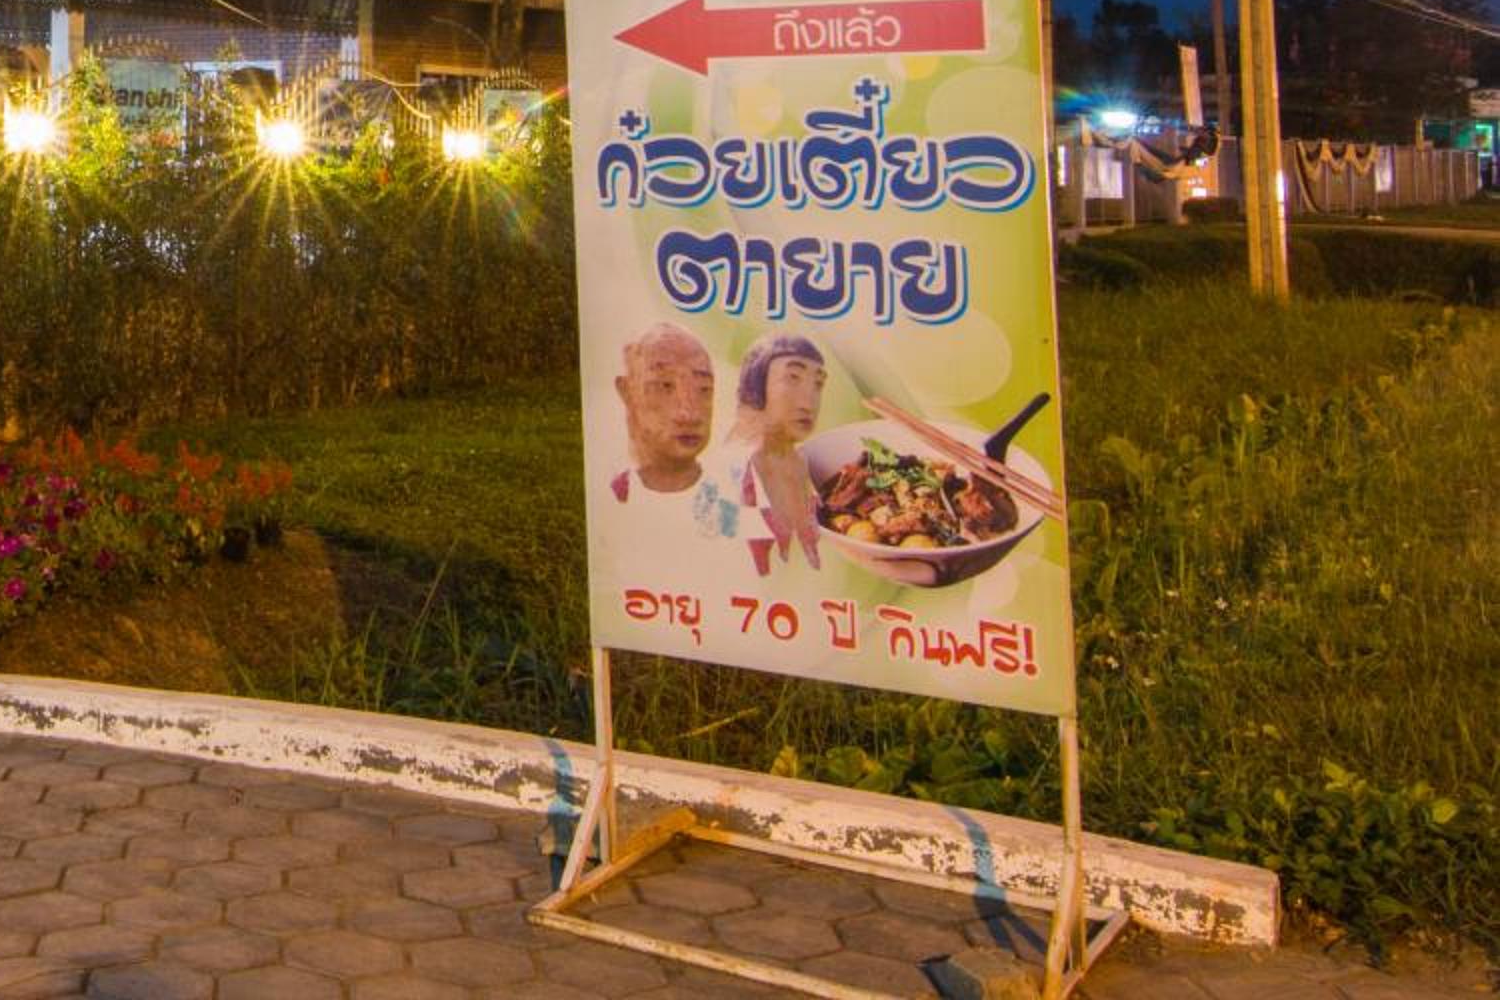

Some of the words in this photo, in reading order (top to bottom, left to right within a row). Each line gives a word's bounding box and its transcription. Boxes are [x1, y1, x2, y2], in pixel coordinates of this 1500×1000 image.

[772, 7, 903, 51] ถึงแล้ว
[597, 77, 1037, 214] ก๋วยเตี๋ยว
[656, 230, 969, 327] ตายาย
[624, 588, 702, 646] อายุ
[730, 595, 800, 642] 70
[820, 599, 858, 651] ปี
[878, 603, 1039, 678] กินฟรี!
